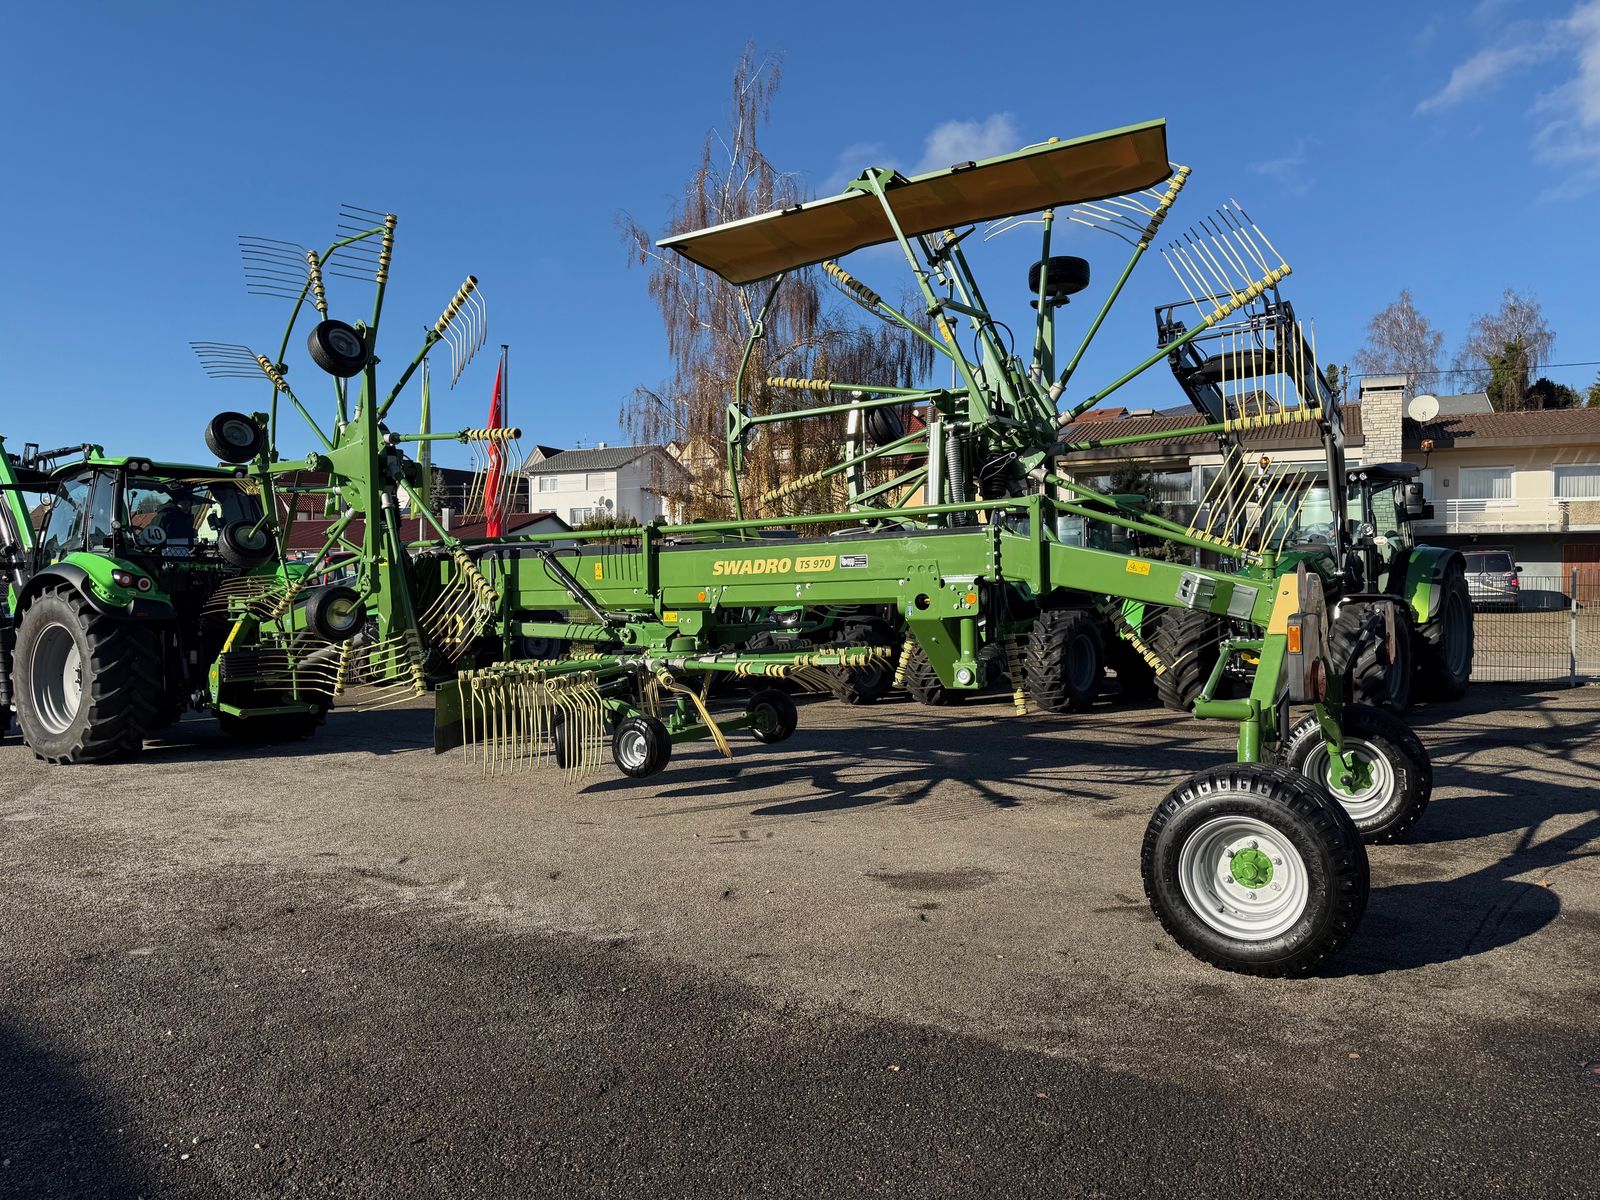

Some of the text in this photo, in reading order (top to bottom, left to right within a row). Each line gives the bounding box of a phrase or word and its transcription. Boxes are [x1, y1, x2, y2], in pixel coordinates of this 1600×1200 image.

[148, 528, 162, 540] 40
[712, 558, 792, 575] SWADRO
[800, 560, 810, 569] TS
[813, 559, 831, 569] 970
